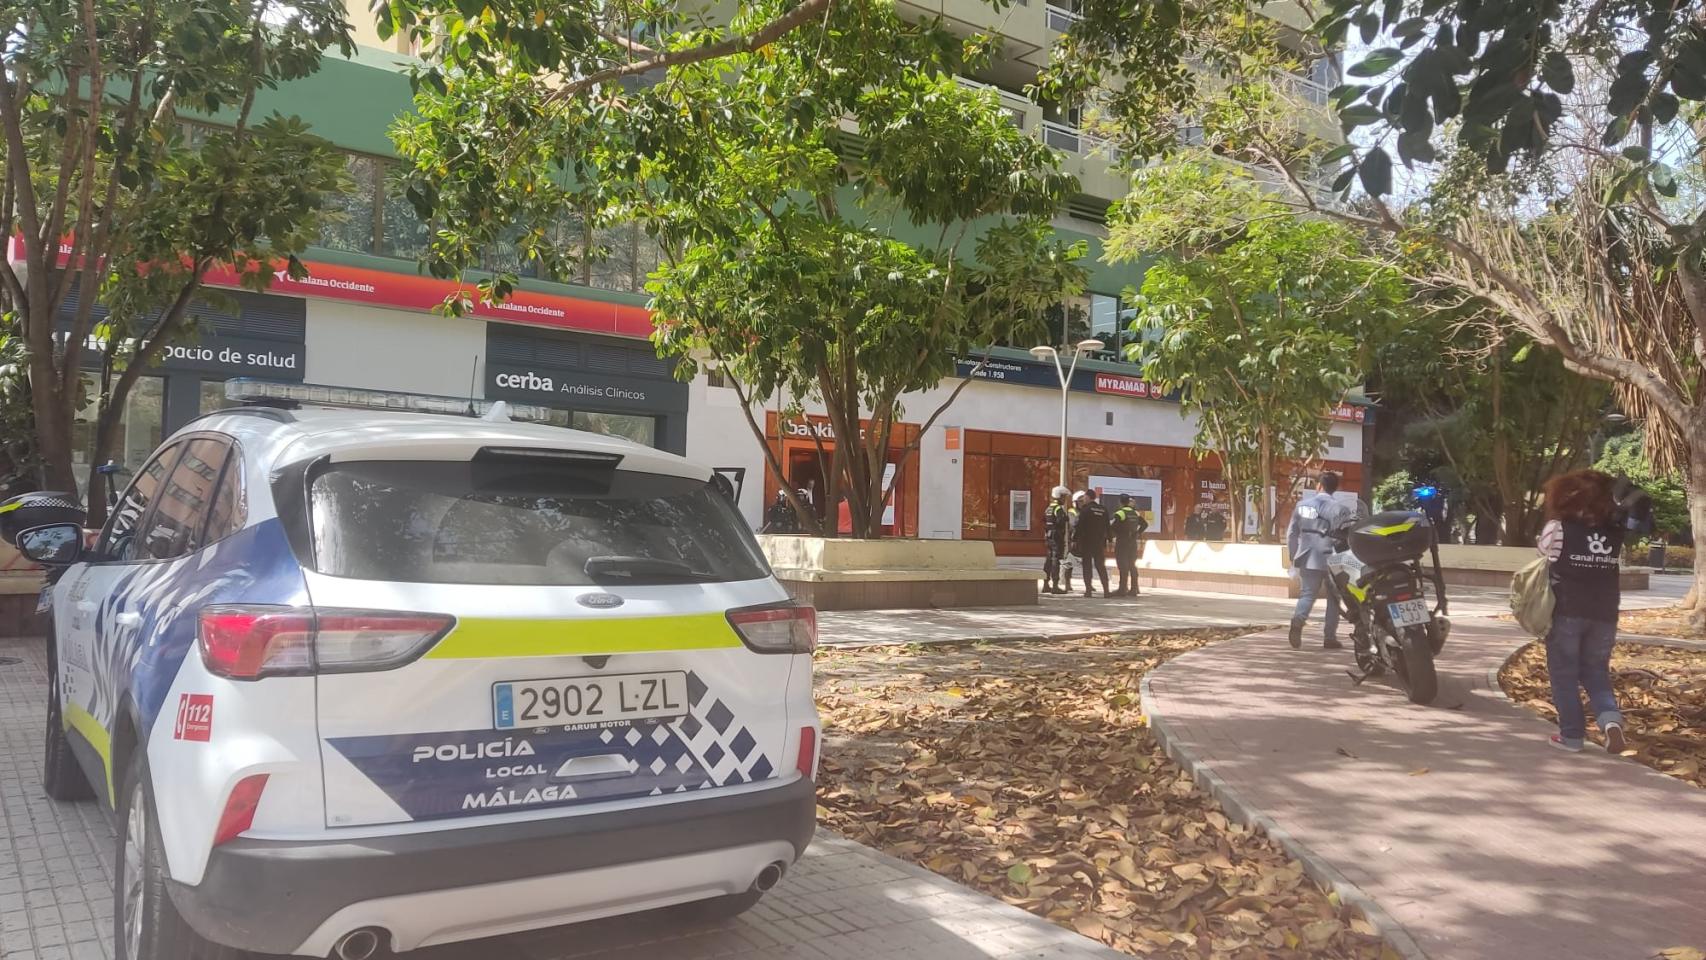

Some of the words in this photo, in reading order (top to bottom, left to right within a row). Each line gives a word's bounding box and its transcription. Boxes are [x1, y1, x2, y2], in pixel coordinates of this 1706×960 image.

[330, 279, 374, 293] Occidente
[495, 302, 527, 312] atalana
[527, 305, 565, 317] Occidente
[219, 347, 242, 363] de
[247, 352, 295, 368] salud
[495, 371, 554, 391] cerba
[560, 383, 603, 397] Análisis
[605, 386, 645, 400] Clínicos
[1098, 377, 1145, 393] MYRAMAR
[1570, 554, 1594, 562] canal
[1399, 601, 1424, 613] 5426
[1401, 610, 1421, 623] LJJ
[520, 683, 604, 721] 2902
[187, 703, 210, 722] 112
[564, 723, 597, 732] GARUM
[600, 719, 631, 728] MOTOR
[412, 737, 536, 763] POLICÍA
[486, 764, 548, 778] LOCAL
[461, 784, 578, 809] MÁLAGA
